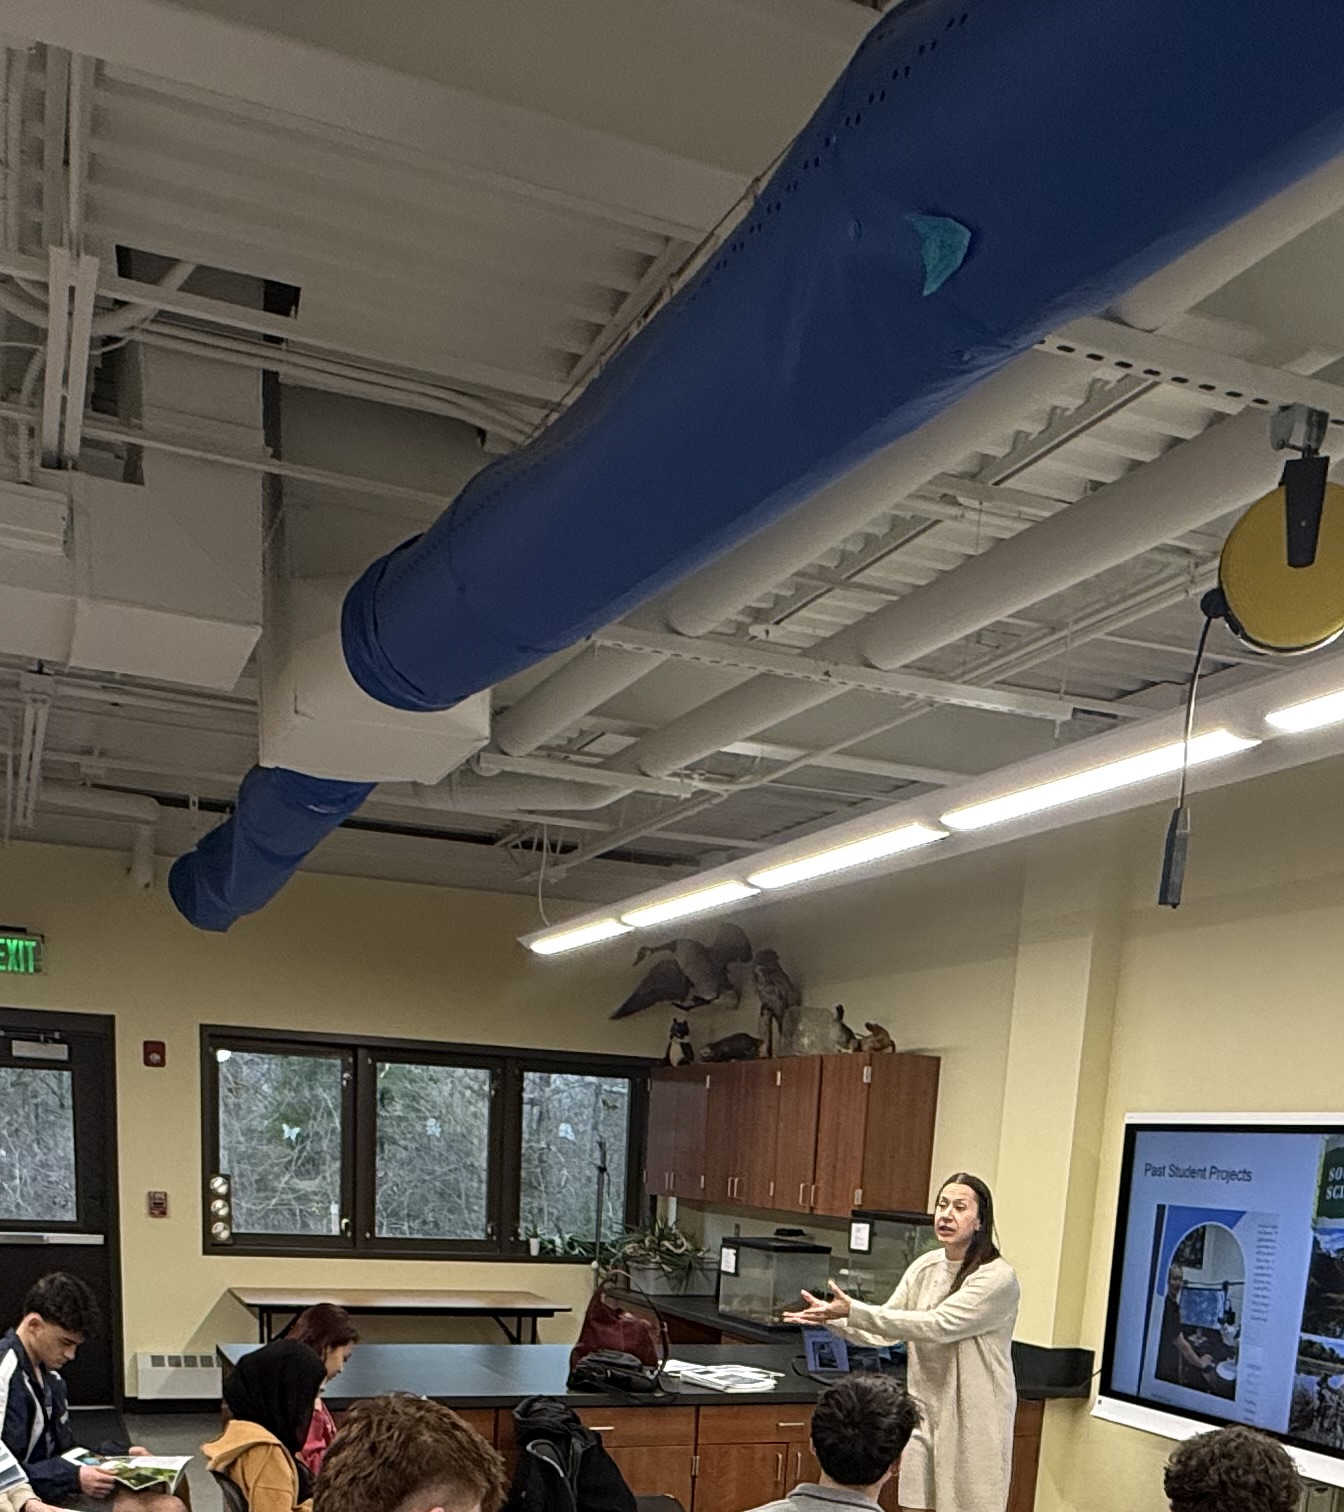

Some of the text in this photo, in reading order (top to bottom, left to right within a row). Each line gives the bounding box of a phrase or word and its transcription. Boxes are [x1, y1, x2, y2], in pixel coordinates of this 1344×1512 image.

[1144, 1163, 1252, 1184] Past Student Projects
